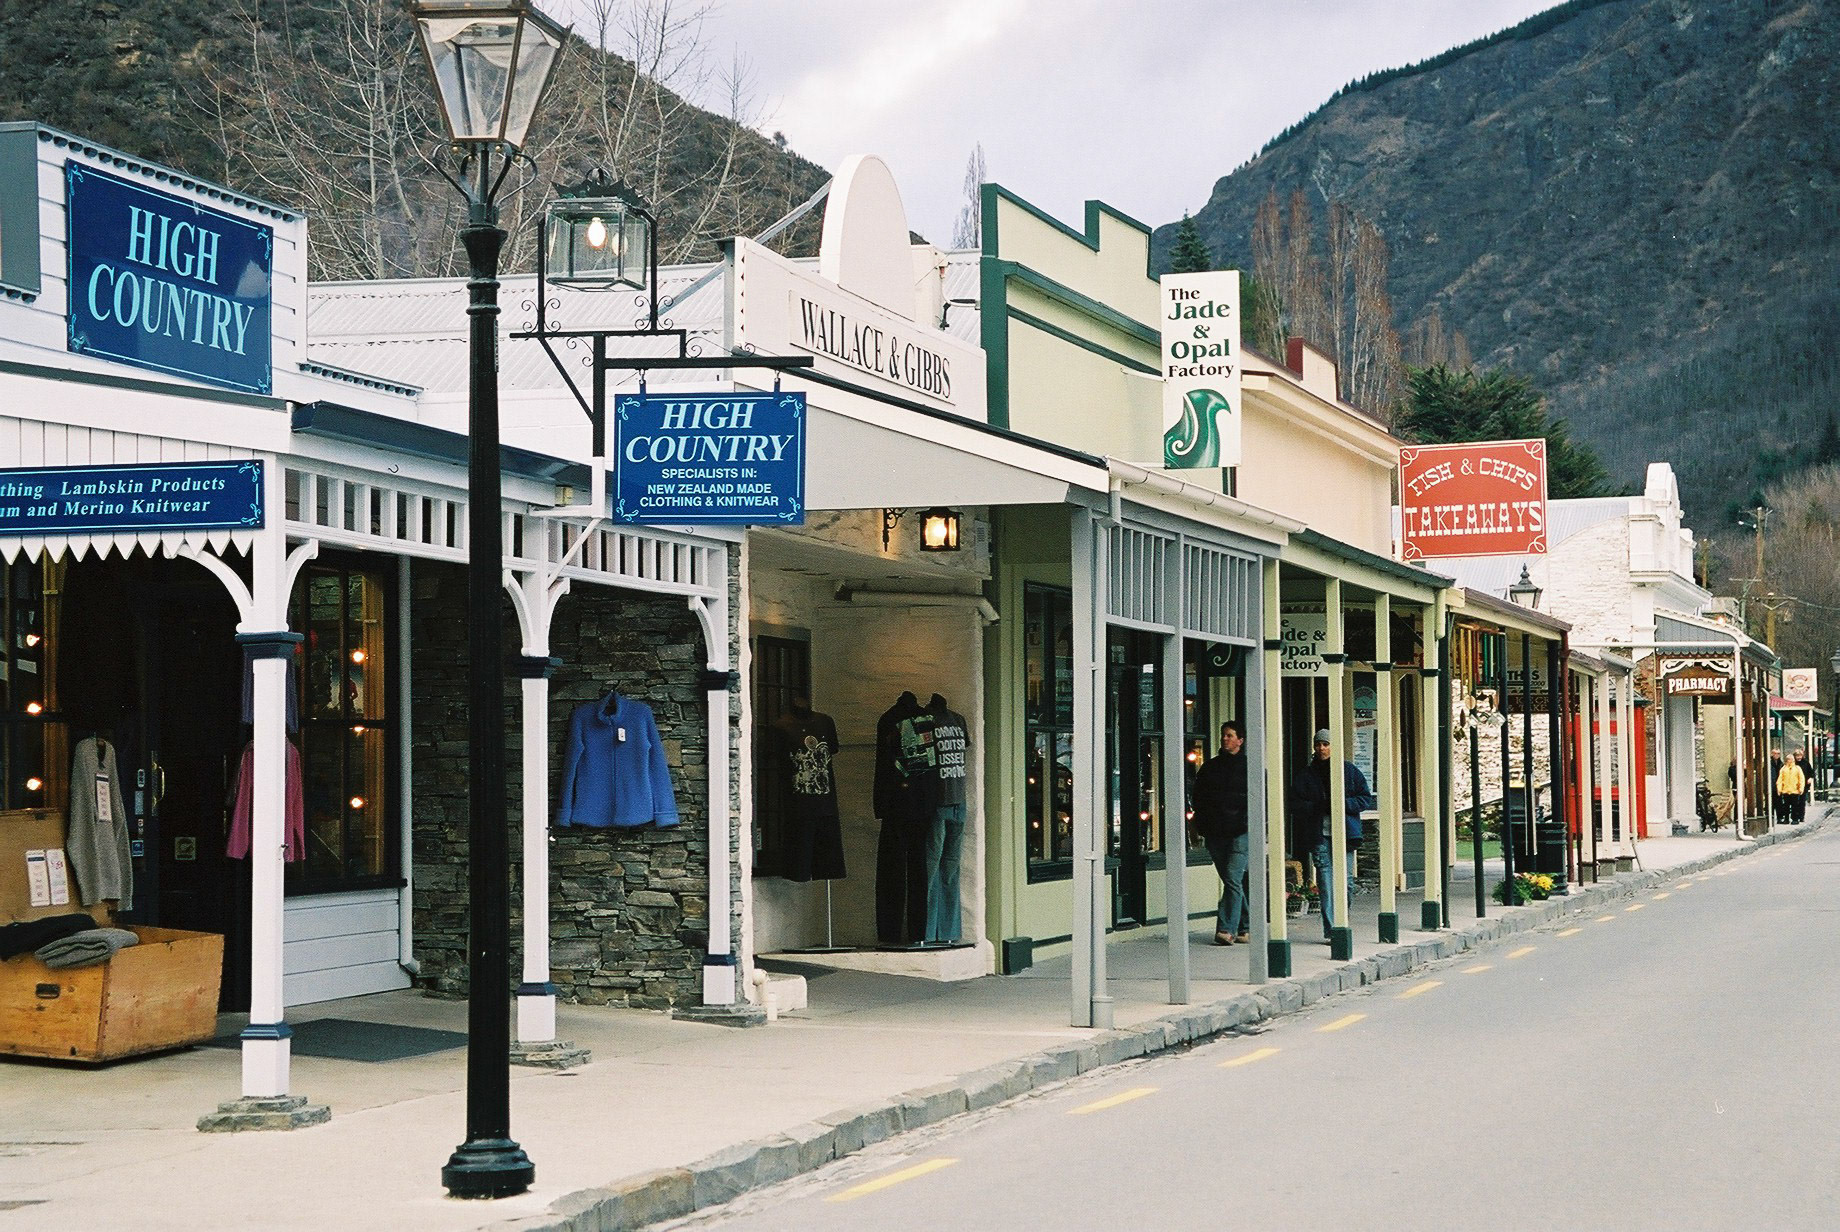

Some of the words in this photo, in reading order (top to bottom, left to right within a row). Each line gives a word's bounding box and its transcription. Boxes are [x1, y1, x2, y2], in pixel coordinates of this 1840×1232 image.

[126, 205, 221, 285] HIGH
[1168, 288, 1201, 300] The
[88, 263, 255, 356] COUNTRY
[1168, 301, 1230, 320] Jade
[1193, 324, 1210, 339] &
[800, 298, 884, 373] WALLACE
[889, 336, 900, 380] &
[904, 343, 951, 399] GIBBS
[1170, 338, 1230, 363] Opal
[1168, 364, 1234, 378] Factory
[659, 402, 757, 430] HIGH
[625, 434, 795, 463] COUNTRY
[661, 468, 739, 479] SPECIALISTS
[741, 468, 758, 478] IN:
[1407, 461, 1454, 497] FISH
[1460, 458, 1474, 476] &
[1479, 457, 1538, 491] CHIPS
[60, 480, 143, 496] Lambskin
[150, 477, 226, 493] Products
[647, 484, 675, 494] NEW
[678, 484, 734, 494] ZEALAND
[737, 483, 772, 494] MADE
[27, 502, 57, 517] and
[63, 500, 124, 516] Merino
[131, 498, 211, 514] Knitwear
[640, 496, 704, 507] CLOTHING
[706, 497, 714, 507] &
[717, 496, 779, 507] KNITWEAR
[1405, 500, 1542, 538] TAKEAWAYS
[1280, 628, 1308, 641] de
[1313, 629, 1326, 641] &
[1280, 660, 1321, 672] ctory
[1668, 677, 1728, 694] PHARMACY
